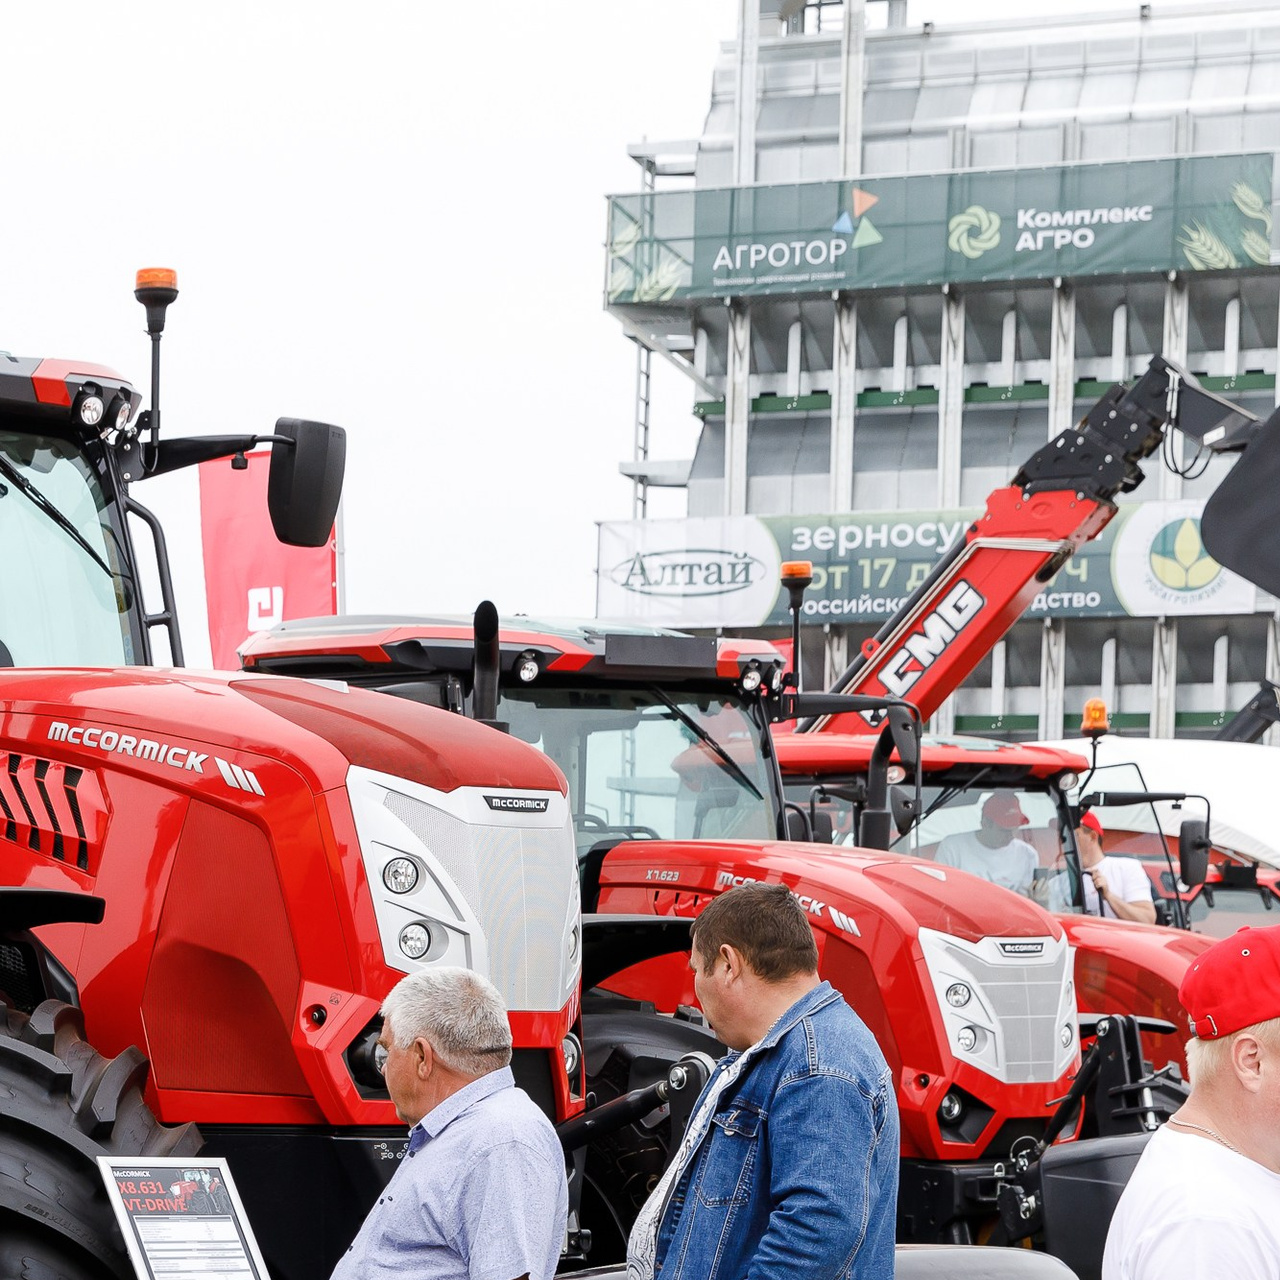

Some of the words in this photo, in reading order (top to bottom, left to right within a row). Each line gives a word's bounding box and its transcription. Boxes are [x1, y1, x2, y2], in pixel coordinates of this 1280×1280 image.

[1017, 205, 1153, 229] Комплекс
[1015, 227, 1095, 252] АГРО
[712, 238, 848, 271] АГРОТОР
[621, 552, 754, 588] Алтай
[858, 558, 896, 589] 17
[905, 563, 932, 591] д
[1031, 591, 1101, 611] дство
[877, 578, 985, 698] CMG
[646, 869, 680, 882] X7.623
[117, 1181, 166, 1194] X8.631
[123, 1198, 188, 1212] VT-DRIVE
